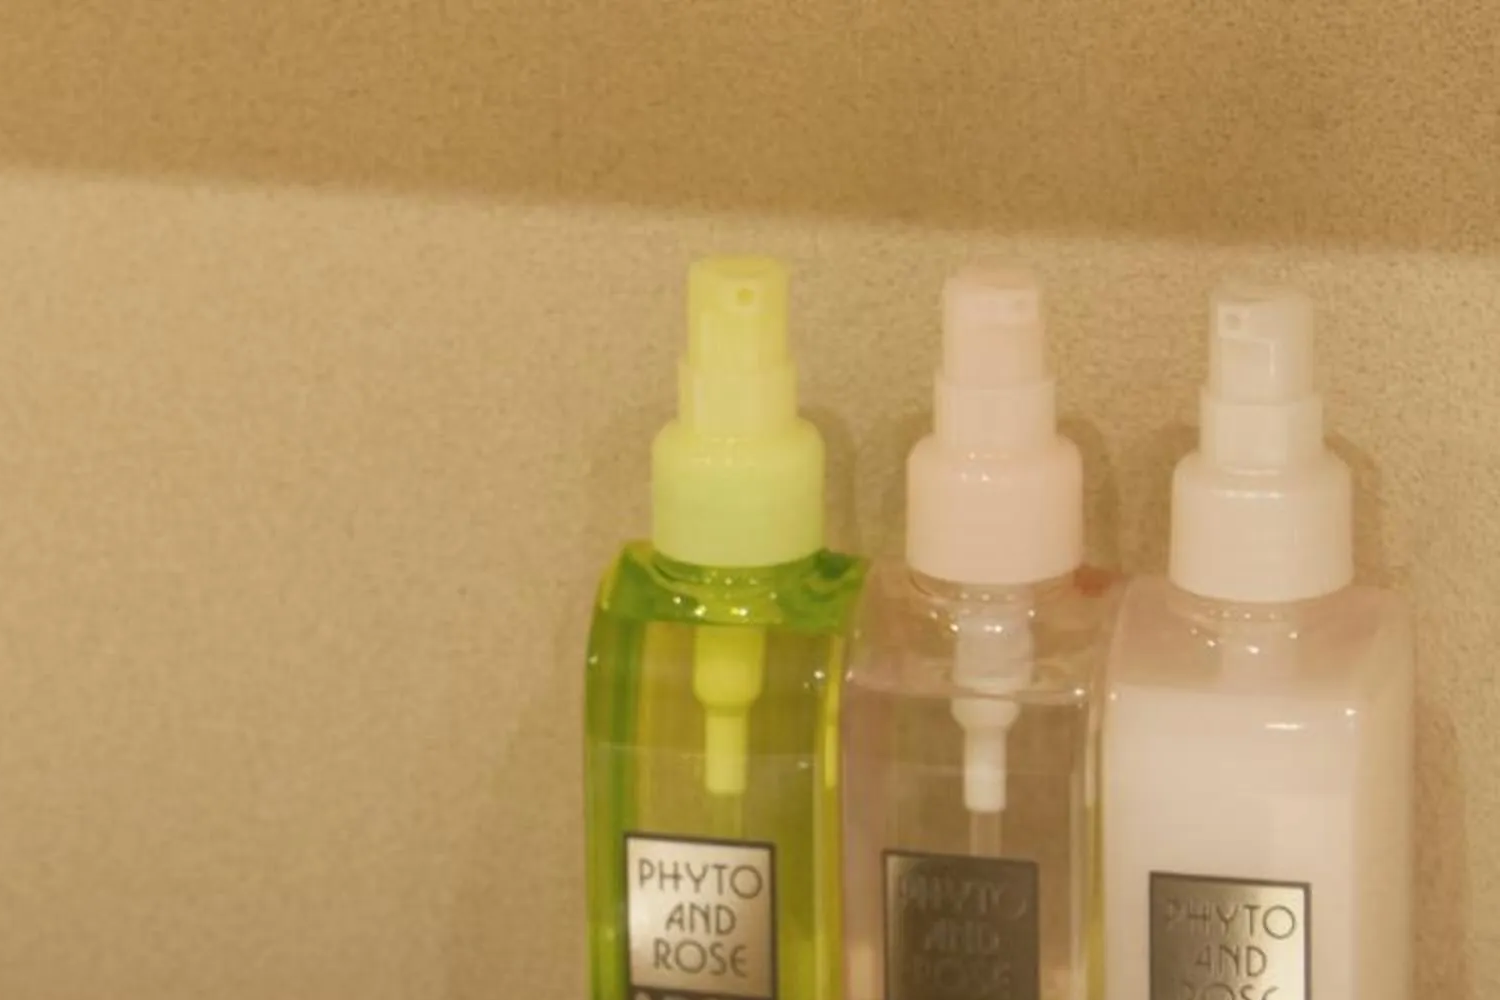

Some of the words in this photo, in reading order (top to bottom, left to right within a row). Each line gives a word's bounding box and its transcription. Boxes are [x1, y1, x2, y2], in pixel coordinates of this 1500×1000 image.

[638, 857, 764, 900] PHYTO
[665, 902, 737, 937] AND
[1164, 898, 1297, 940] PHYTO
[652, 937, 749, 978] ROSE
[1193, 944, 1268, 978] AND
